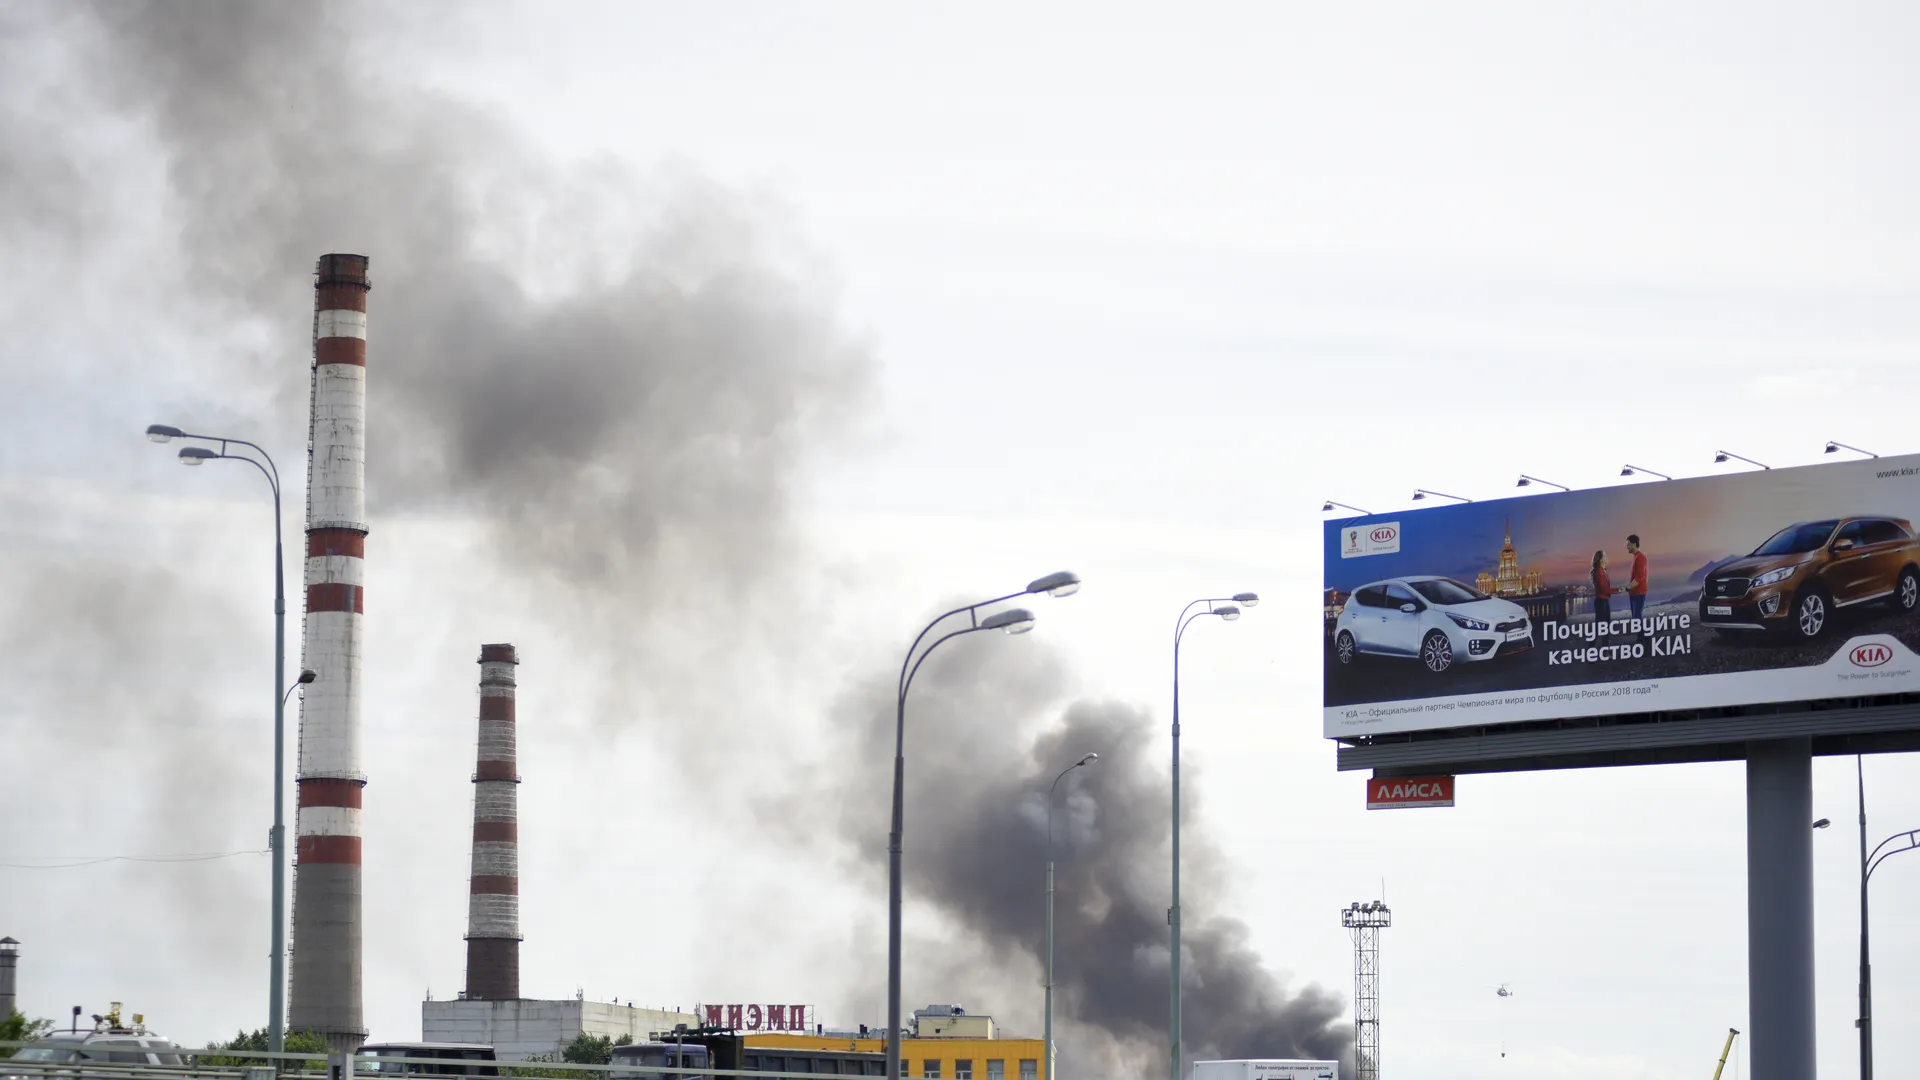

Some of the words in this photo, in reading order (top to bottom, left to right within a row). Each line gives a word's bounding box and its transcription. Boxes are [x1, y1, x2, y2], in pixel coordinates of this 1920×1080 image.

[1543, 612, 1691, 642] Почувствуйте
[1548, 643, 1645, 666] качество
[1651, 634, 1691, 657] KIA!
[1850, 672, 1870, 680] Power
[1345, 710, 1358, 718] KIA
[1368, 705, 1423, 717] Официальный
[1425, 703, 1455, 712] партнер
[1457, 699, 1502, 708] Чемпионата
[1537, 692, 1573, 703] футболу
[1581, 689, 1610, 698] России
[1612, 687, 1631, 696] 2018
[705, 1004, 805, 1030] МИЭМП
